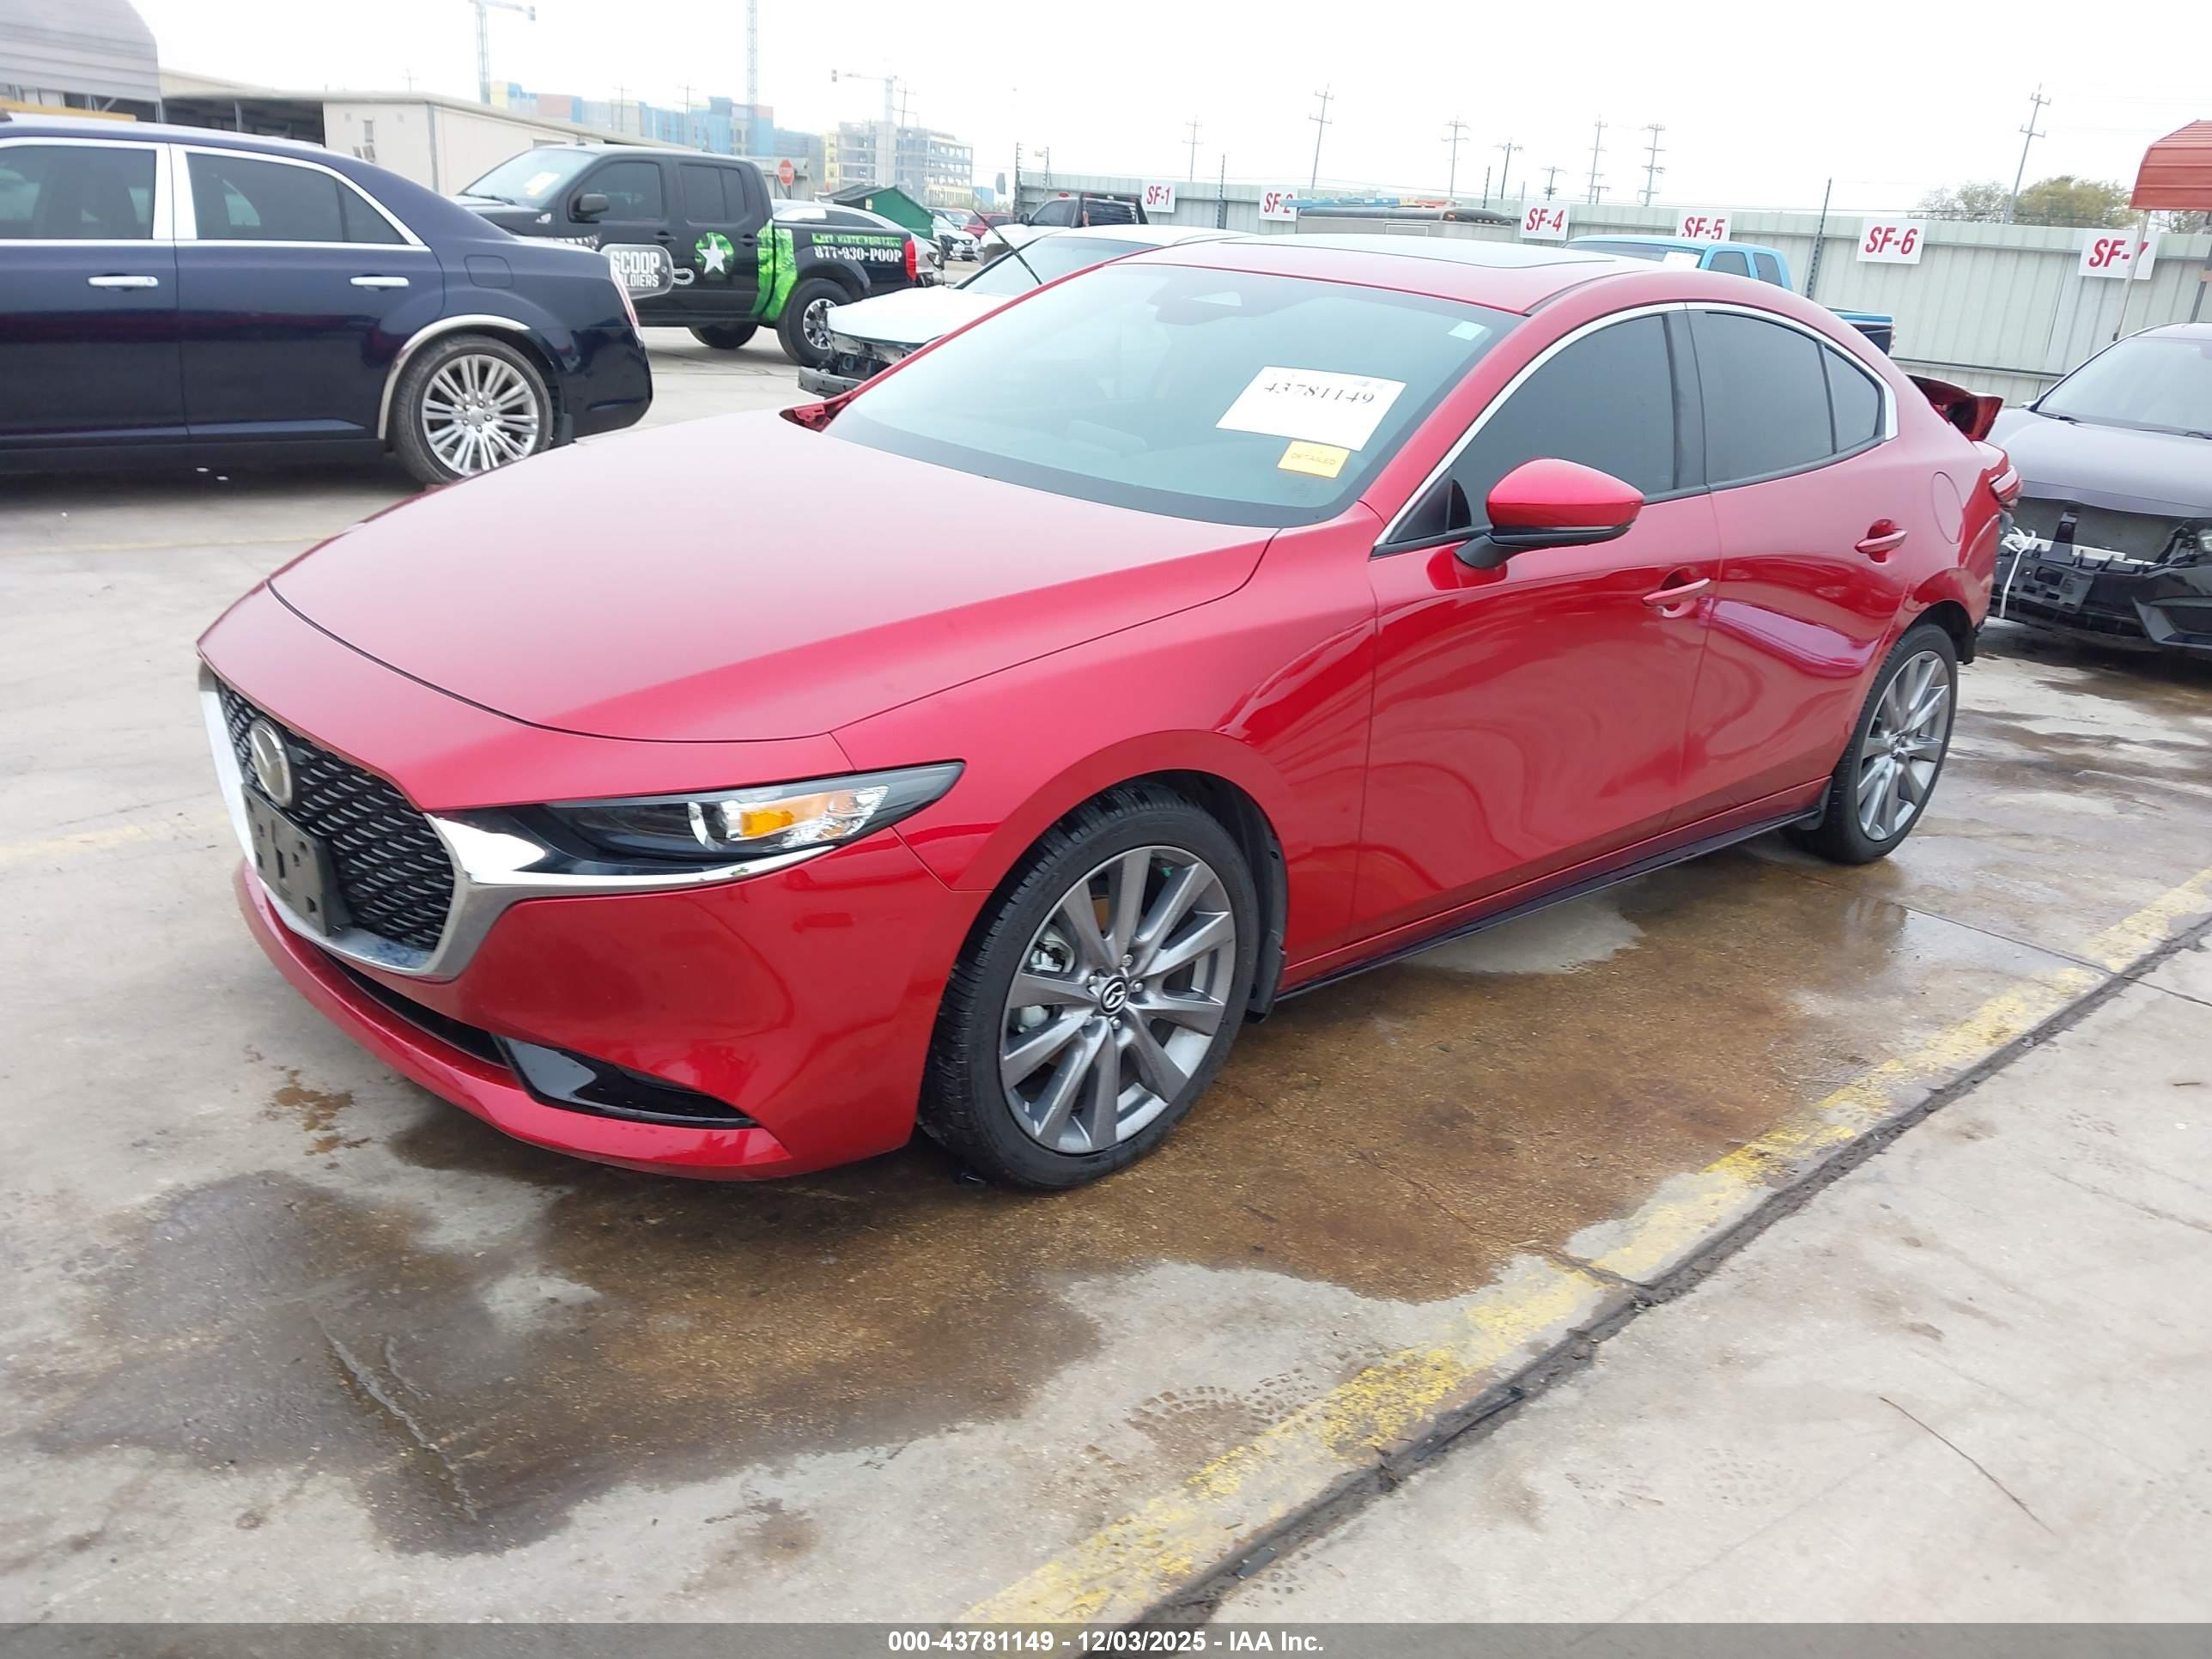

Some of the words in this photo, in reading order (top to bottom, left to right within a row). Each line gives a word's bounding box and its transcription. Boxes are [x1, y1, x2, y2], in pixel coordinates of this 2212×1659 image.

[1146, 185, 1170, 205] SF-1
[1264, 191, 1293, 214] SF2
[1526, 207, 1565, 232] SF-4
[1681, 216, 1726, 240] SF-5
[1865, 226, 1918, 255] SF-6
[813, 245, 902, 263] 877-930-POOP
[1264, 382, 1374, 404] 43781149
